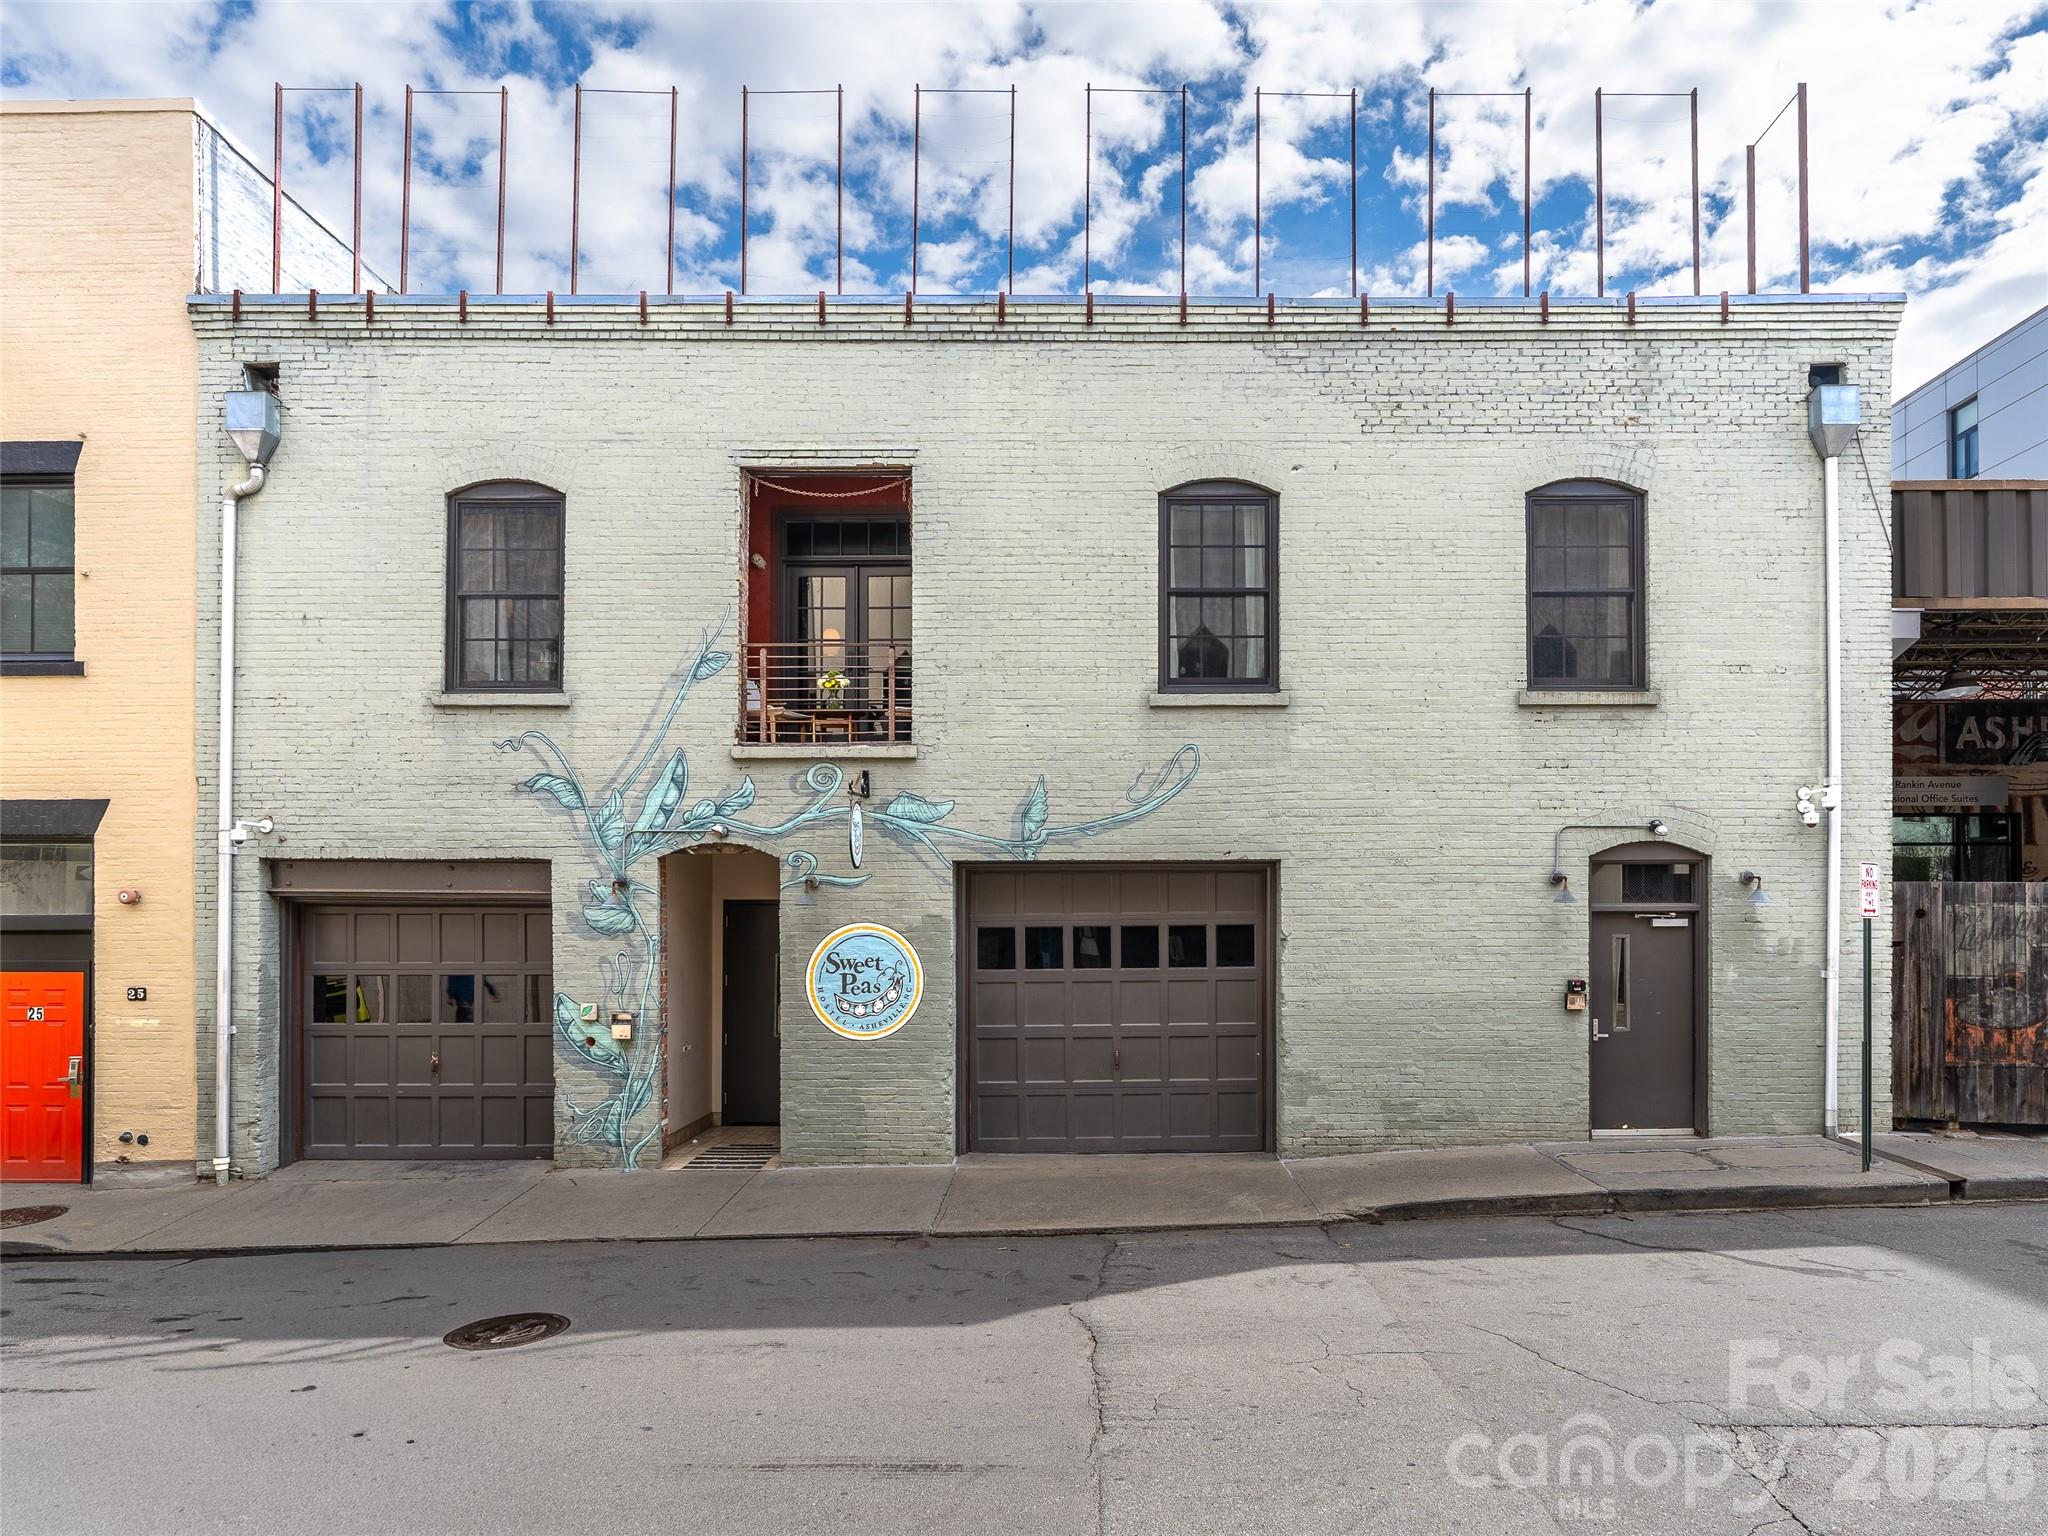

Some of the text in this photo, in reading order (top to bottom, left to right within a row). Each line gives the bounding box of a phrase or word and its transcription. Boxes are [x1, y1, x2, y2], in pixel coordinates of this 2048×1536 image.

[1895, 780, 1962, 789] Rankin Avenue
[1921, 794, 1949, 803] Office
[1951, 794, 1979, 803] Suites
[1865, 867, 1874, 878] NO
[1861, 879, 1878, 890] PARKING
[825, 951, 884, 974] Sweet
[839, 972, 881, 996] Peas
[127, 988, 145, 1000] 25
[817, 986, 848, 1026] HOSTEL
[28, 1007, 43, 1020] 25
